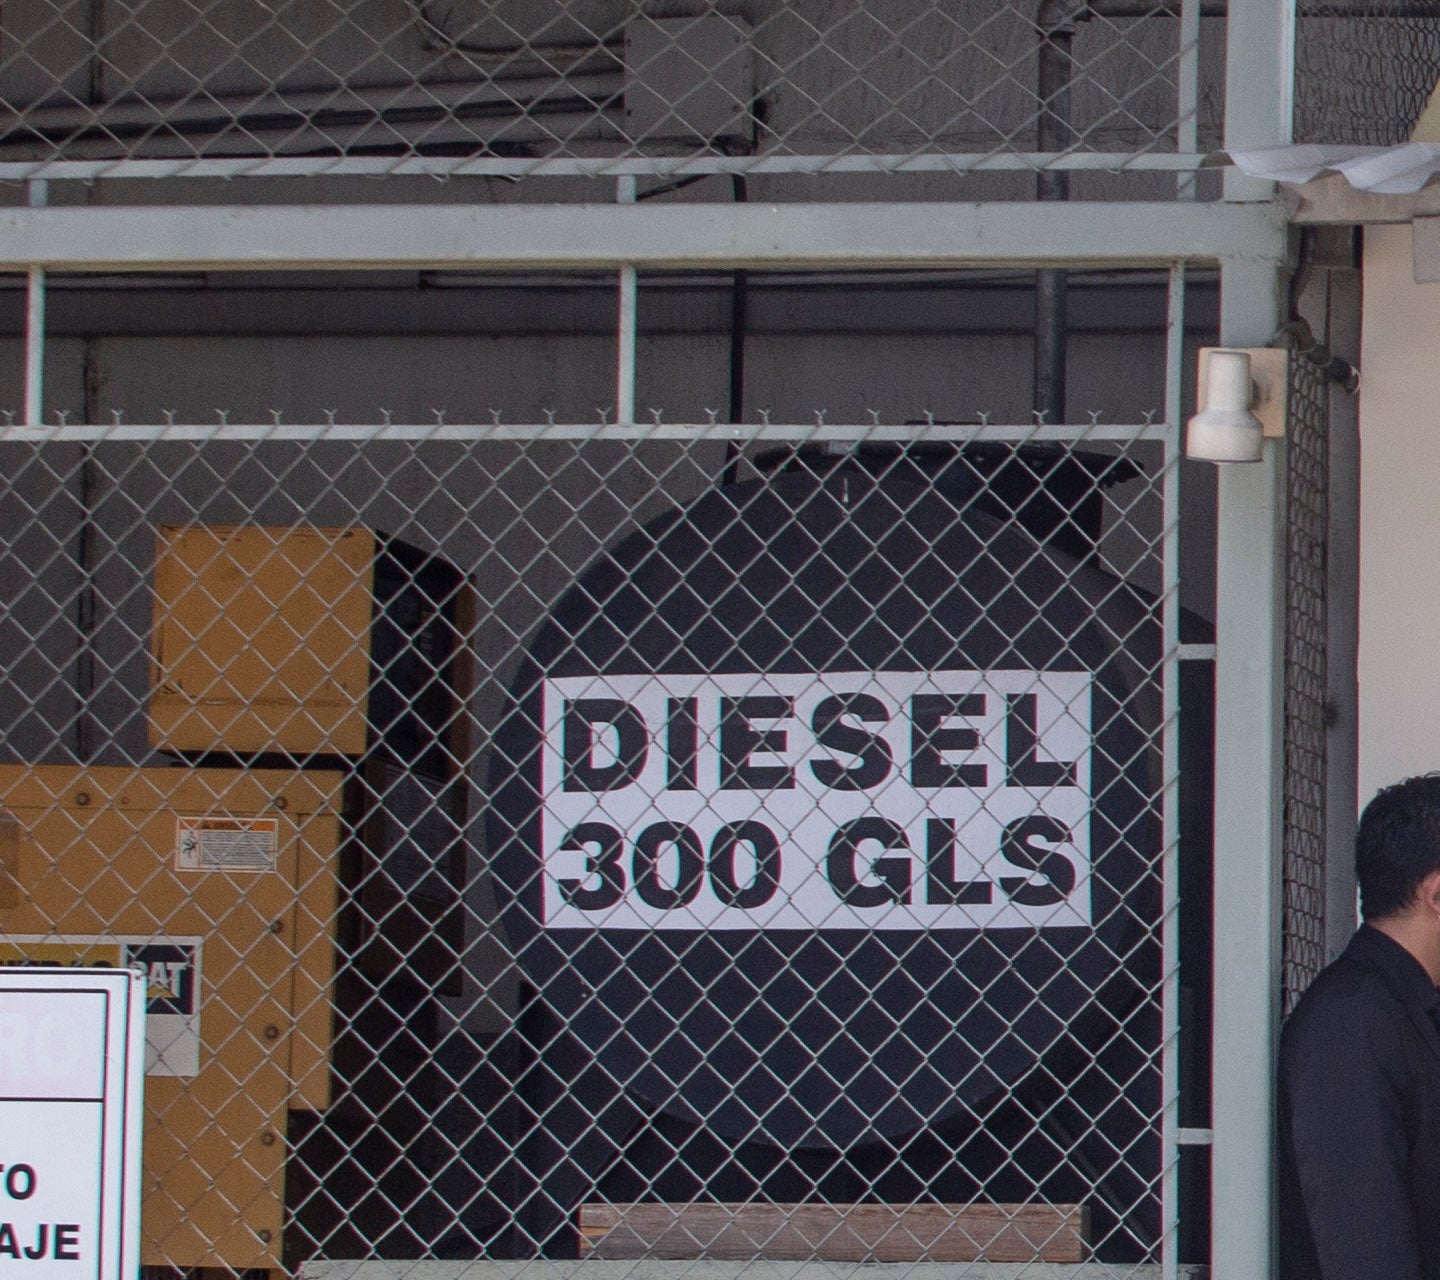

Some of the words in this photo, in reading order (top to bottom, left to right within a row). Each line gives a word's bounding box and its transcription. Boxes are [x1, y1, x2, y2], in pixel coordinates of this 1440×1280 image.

[562, 692, 1077, 792] DIESEL
[557, 820, 782, 910] 300
[826, 815, 1077, 908] GLS
[0, 1163, 36, 1200] O
[0, 1223, 80, 1260] AJE
